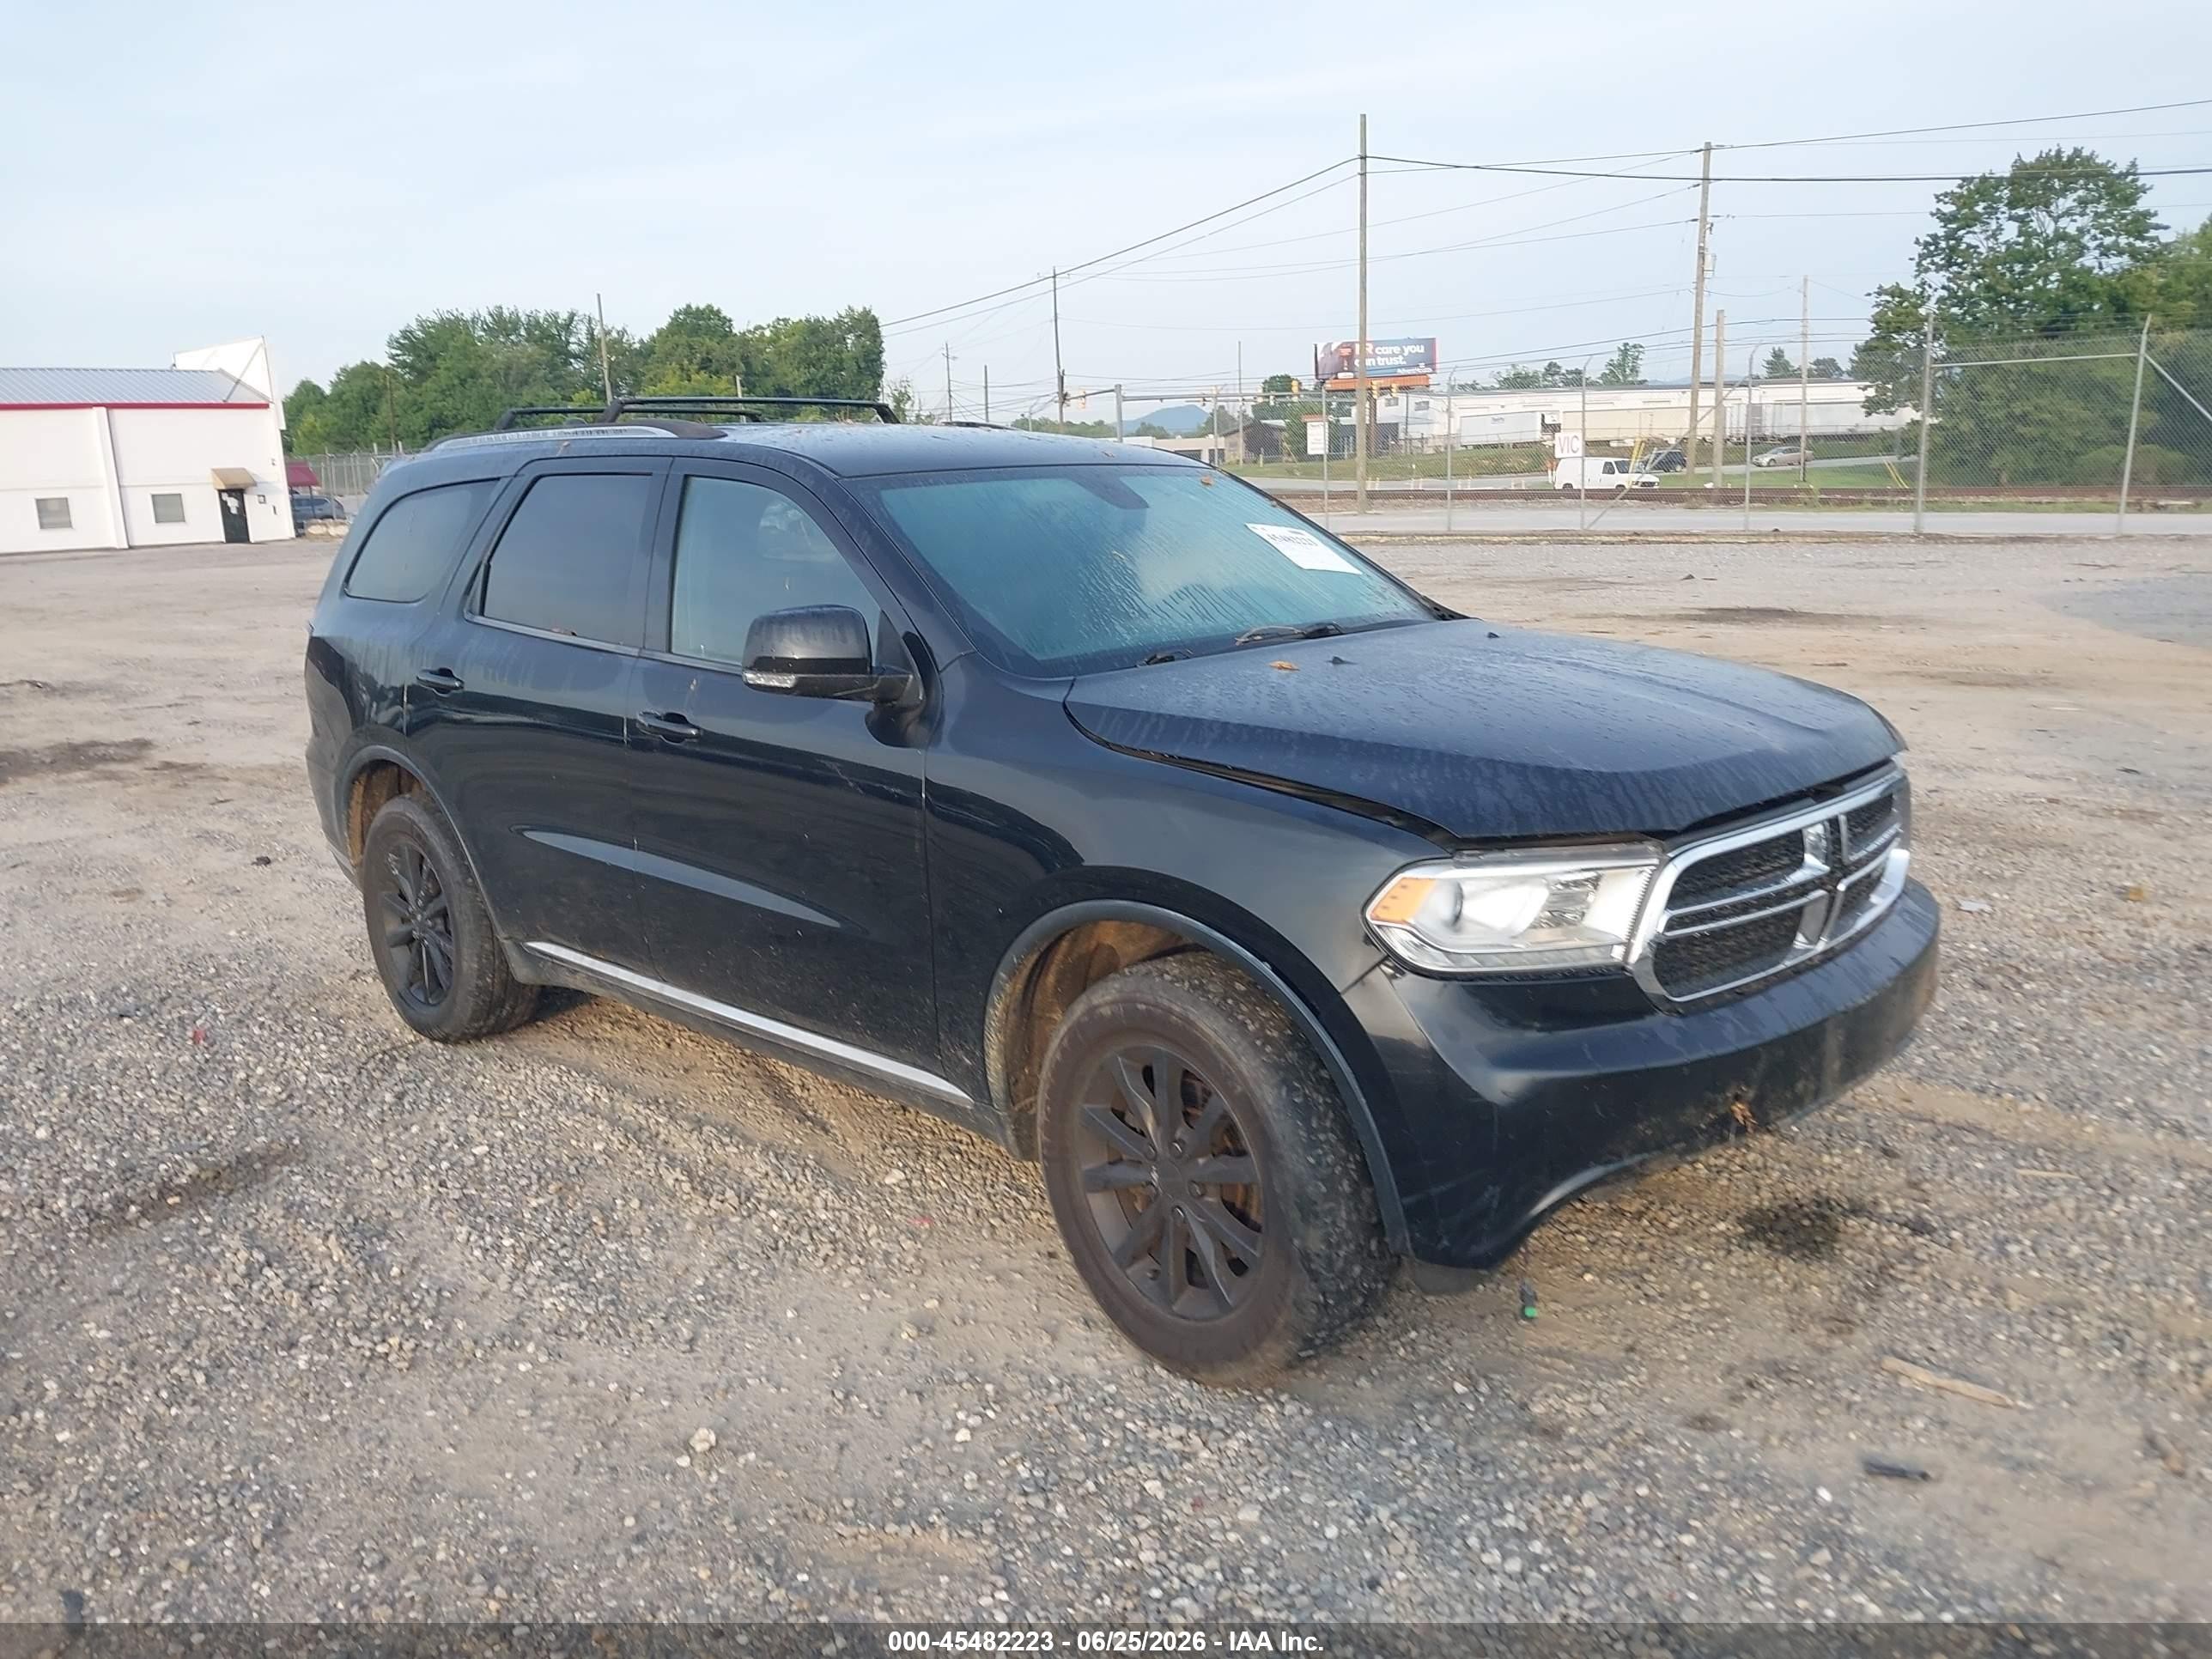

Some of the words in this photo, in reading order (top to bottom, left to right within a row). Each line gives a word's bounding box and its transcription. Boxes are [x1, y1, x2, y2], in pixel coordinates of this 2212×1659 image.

[1375, 346, 1401, 355] care
[1401, 344, 1425, 356] you
[1376, 355, 1407, 366] trust.
[1559, 434, 1579, 454] VIC
